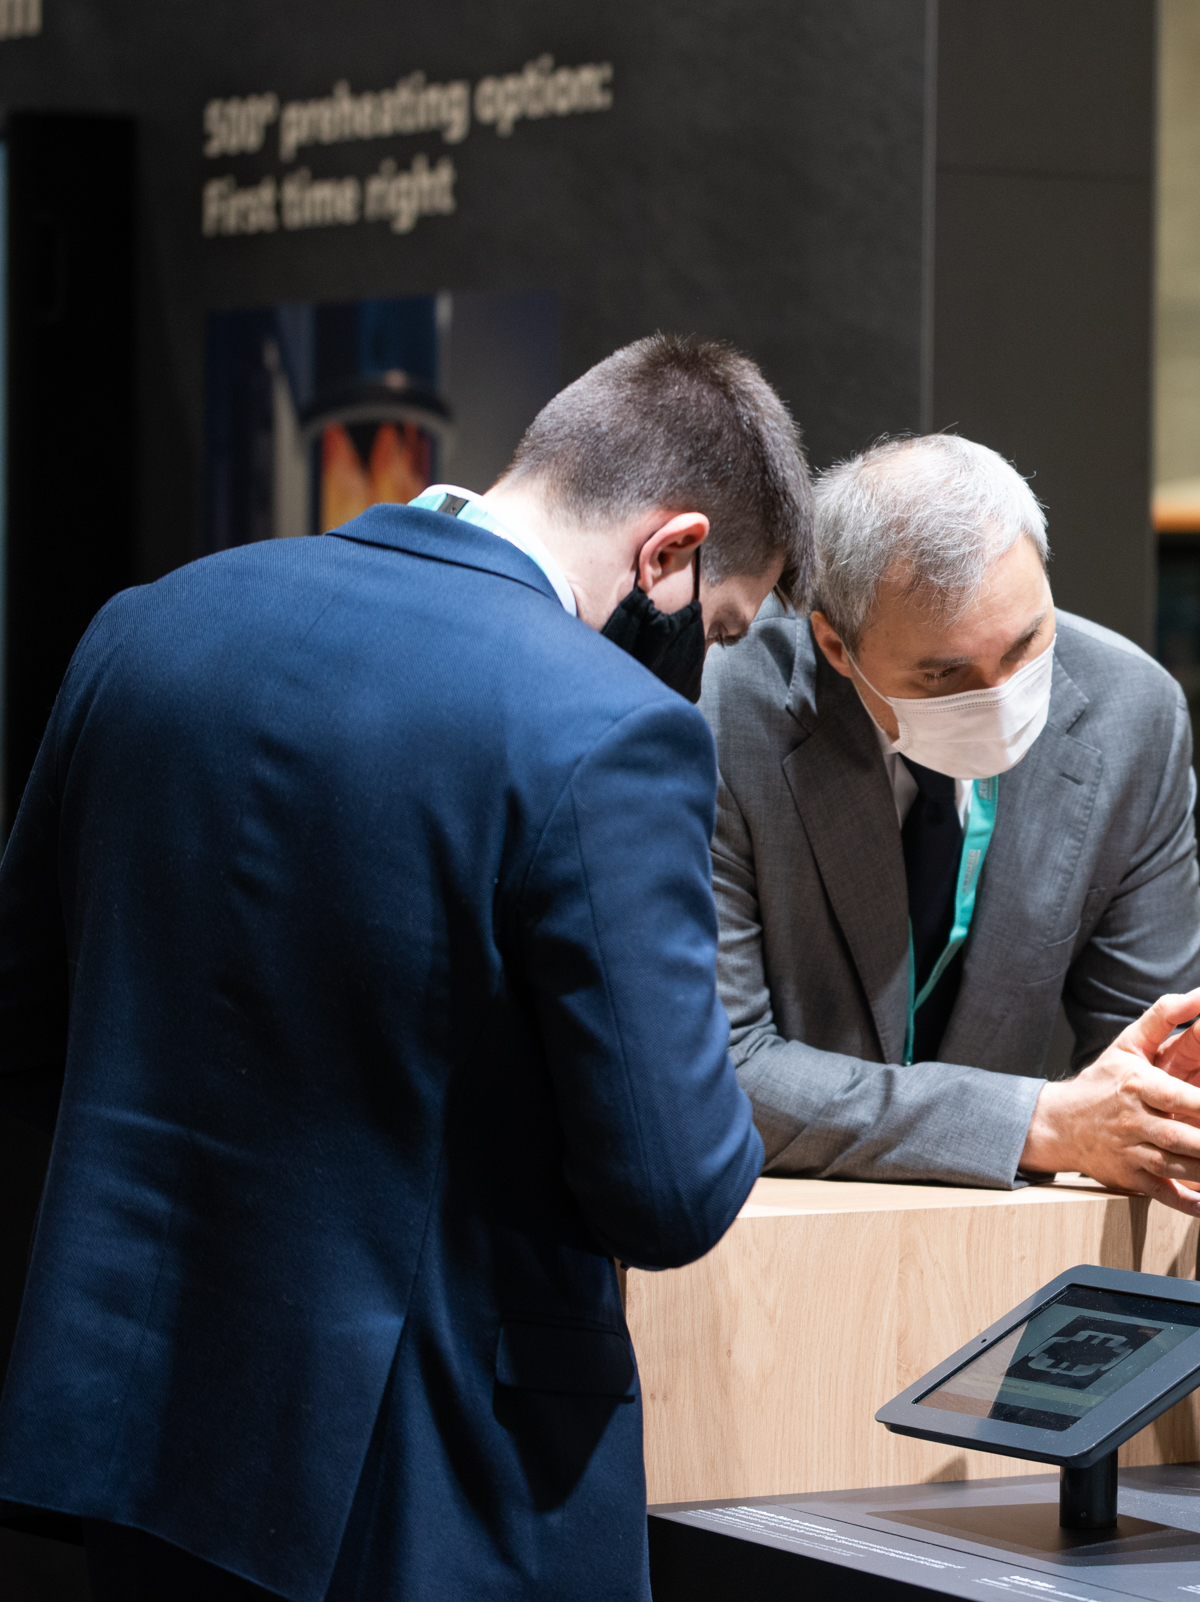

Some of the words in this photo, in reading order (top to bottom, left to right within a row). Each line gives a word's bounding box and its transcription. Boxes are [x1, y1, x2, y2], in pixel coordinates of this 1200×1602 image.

[282, 71, 469, 162] preheating
[475, 53, 612, 137] option:
[202, 174, 278, 237] First
[282, 166, 360, 229] time
[364, 152, 456, 234] right
